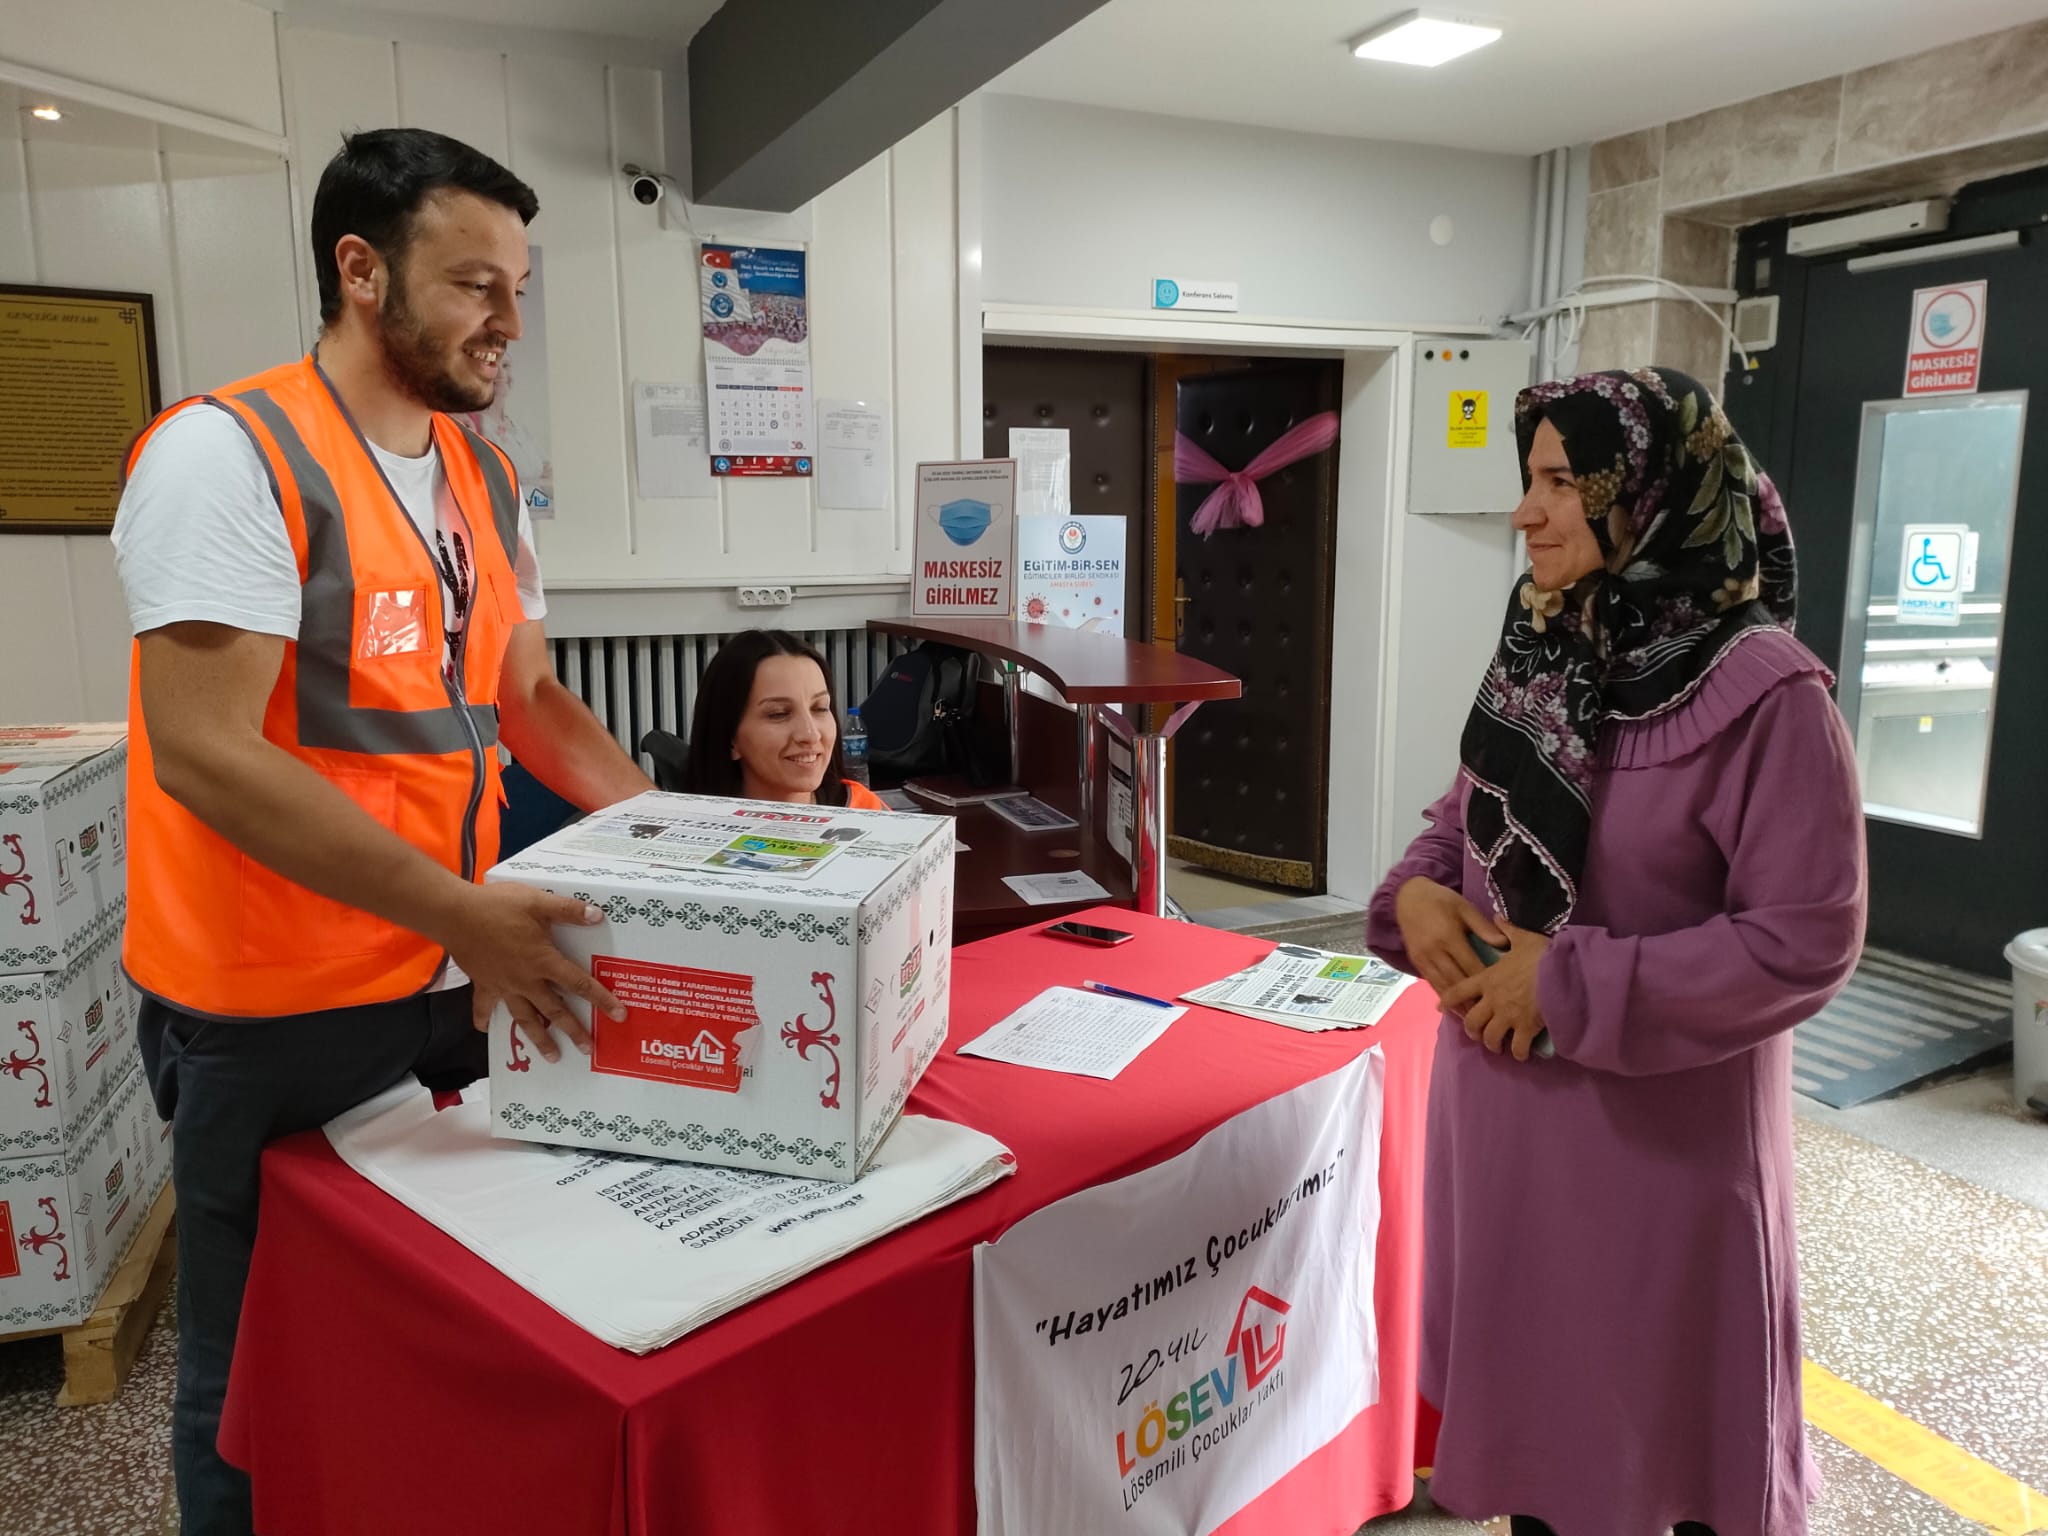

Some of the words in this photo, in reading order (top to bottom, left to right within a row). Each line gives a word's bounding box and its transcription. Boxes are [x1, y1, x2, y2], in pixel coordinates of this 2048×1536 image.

[1911, 352, 1976, 371] MASKESİZ
[1911, 372, 1972, 388] GİRİLMEZ
[924, 557, 1002, 578] MASKESİZ
[926, 584, 998, 605] GİRİLMEZ
[612, 972, 629, 980] KOLİ
[630, 974, 656, 984] İÇERİĞİ
[657, 977, 680, 988] LÖSEV
[682, 981, 727, 993] TARAFINDAN
[615, 981, 656, 993] ÜRÜNLERLE
[657, 986, 692, 998] LÖSEMİLİ
[612, 989, 629, 998] ÖZEL
[632, 992, 661, 1002] OLARAK
[662, 995, 715, 1011] HAZIRLATILMIŞ
[652, 1003, 668, 1013] İÇİN
[669, 1006, 684, 1015] SİZE
[686, 1008, 721, 1021] ÜCRETSİZ
[641, 1039, 699, 1061] LÖSEV
[640, 1055, 671, 1067] Lösemili
[671, 1059, 704, 1071] Çocuklar
[705, 1064, 724, 1075] Vakfı
[556, 1167, 592, 1186] 0312
[596, 1163, 664, 1196] İSTANBU
[606, 1182, 652, 1202] İZMİR
[619, 1184, 674, 1209] BURSA
[633, 1184, 702, 1216] ANTALYA
[643, 1187, 723, 1223] ESKİŞEHİR
[679, 1215, 733, 1244] ADANA
[786, 1185, 810, 1198] 322
[690, 1214, 755, 1249] SAMSUN
[801, 1191, 824, 1201] 362
[823, 1184, 849, 1195] 230
[1035, 1256, 1198, 1346] "Hayatımız
[1205, 1148, 1344, 1278] Çocuklarımız"
[1116, 1355, 1237, 1480] LÖSEV
[1122, 1452, 1186, 1512] Lösemili
[1190, 1398, 1253, 1464] Çocuklar
